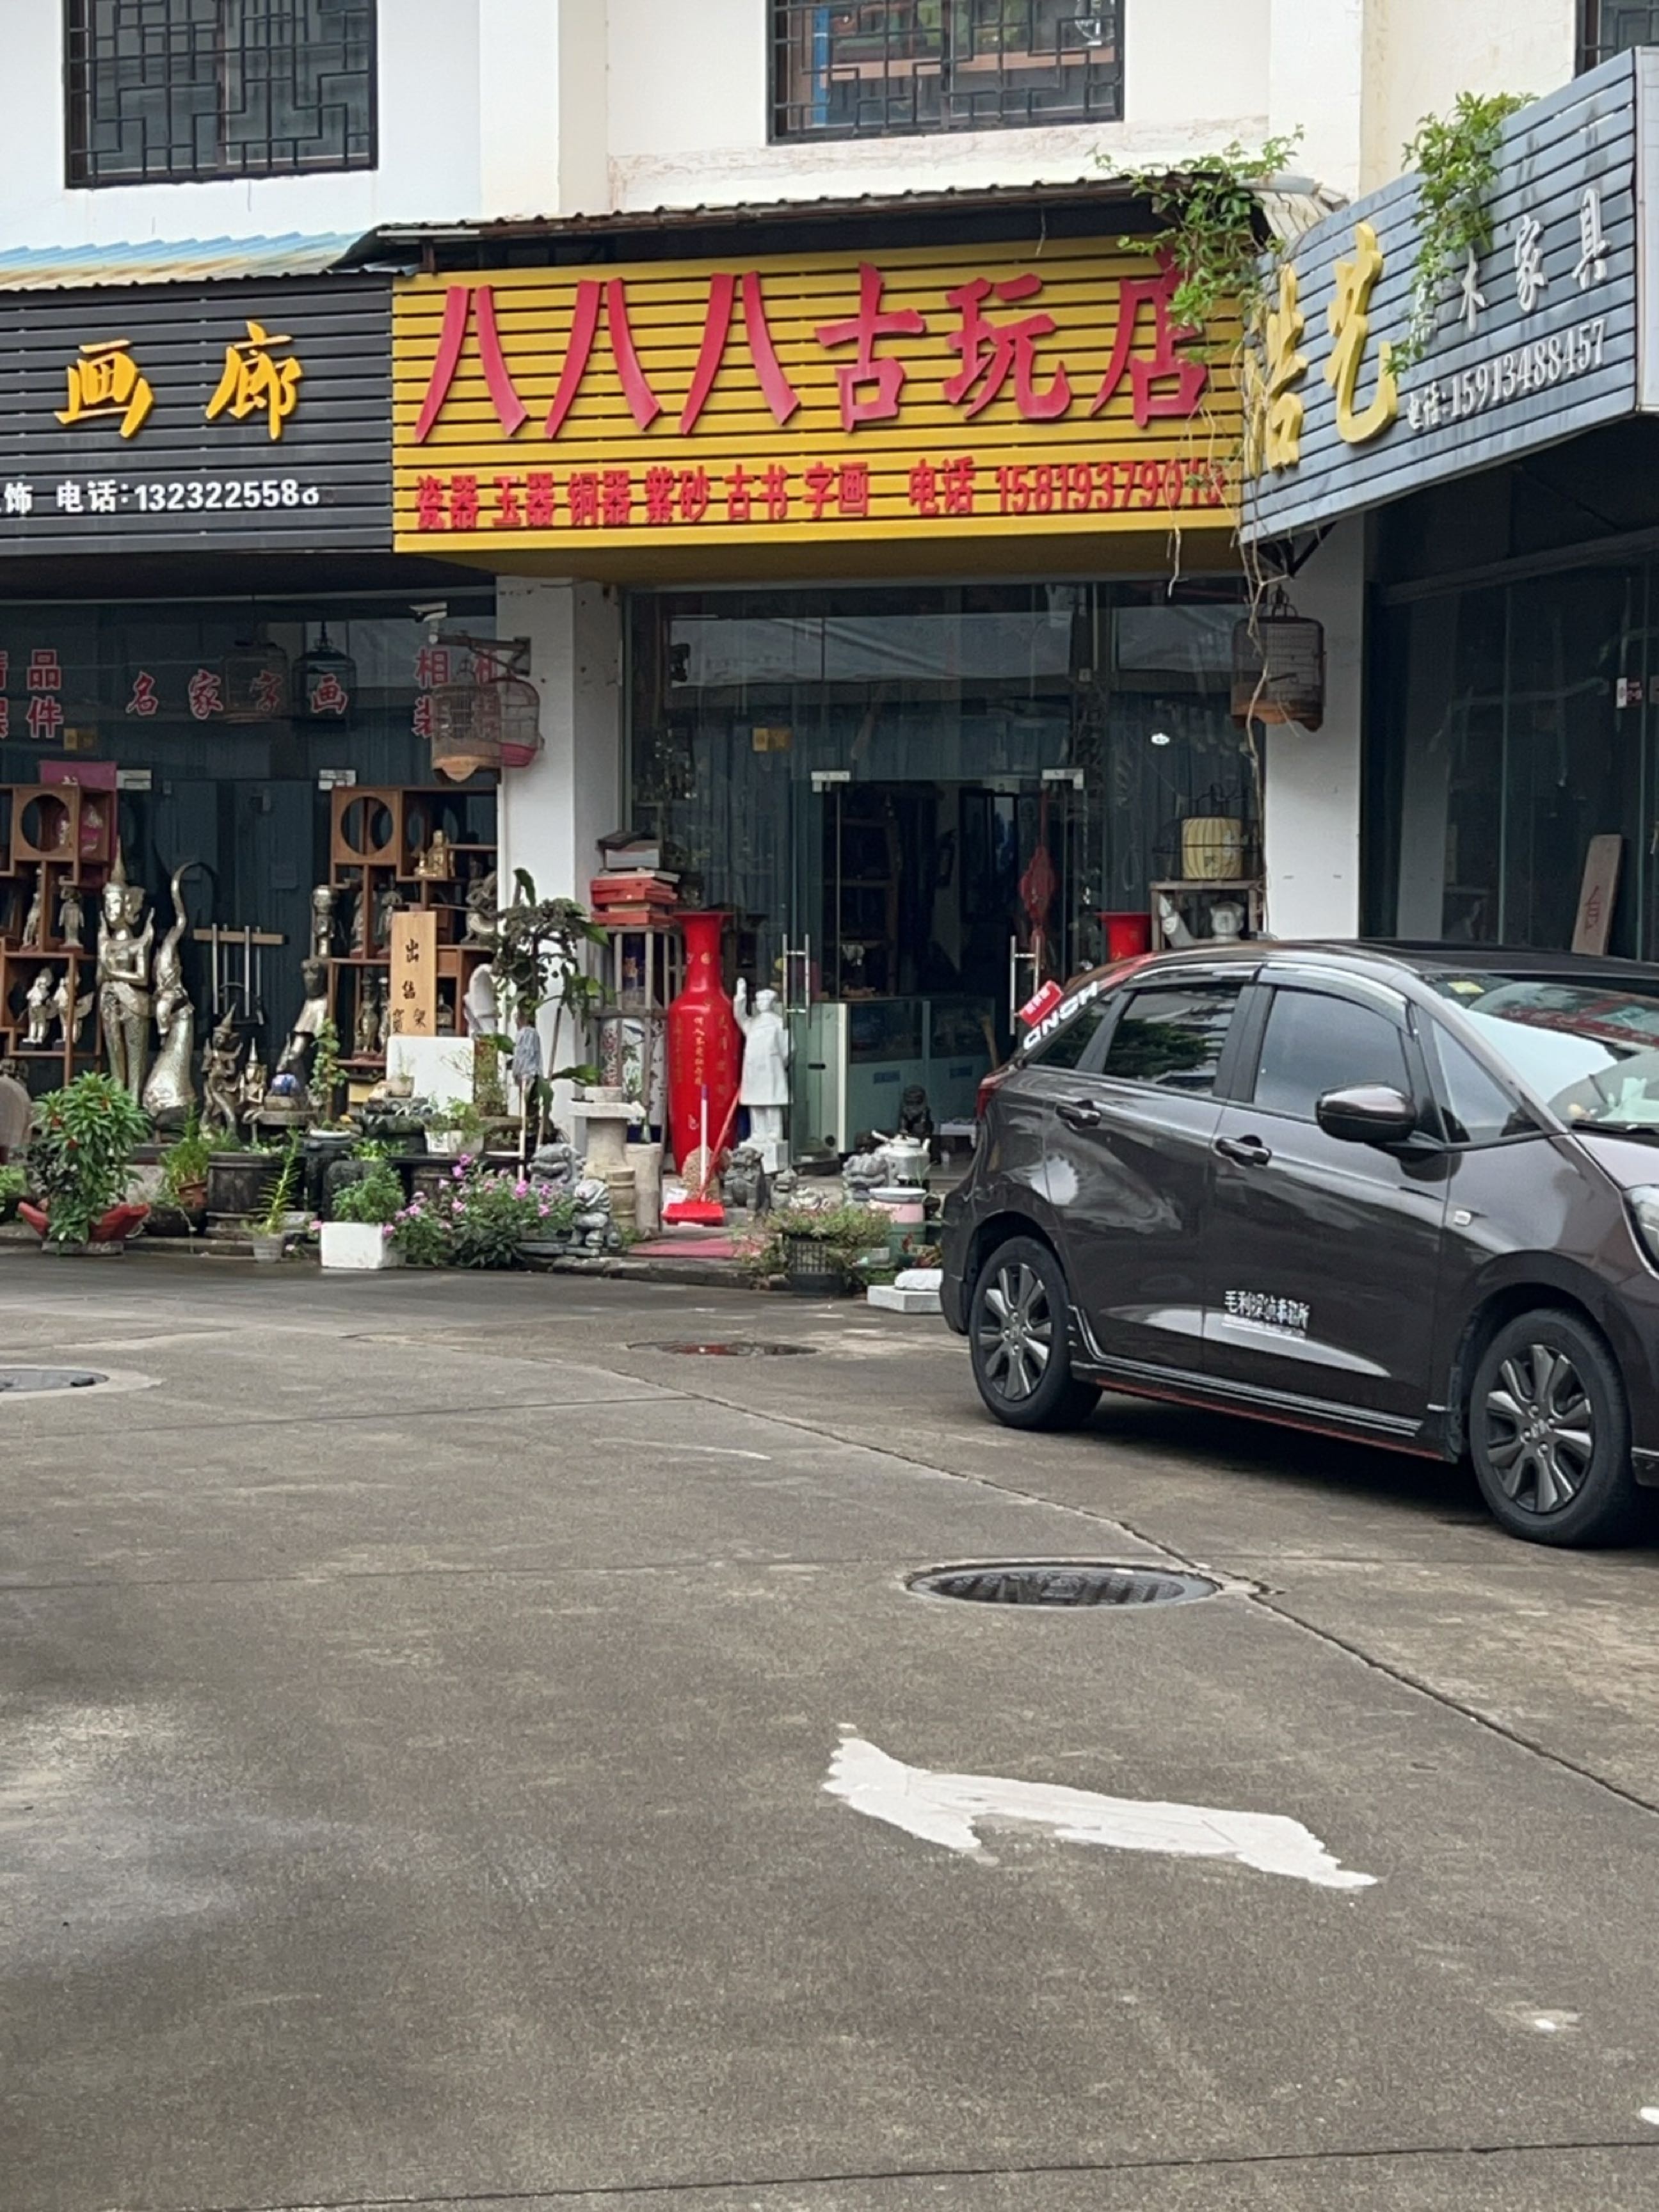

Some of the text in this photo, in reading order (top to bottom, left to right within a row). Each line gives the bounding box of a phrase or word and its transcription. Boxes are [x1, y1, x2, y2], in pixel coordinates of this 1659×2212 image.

[54, 322, 303, 441] 画廊
[415, 253, 1208, 443] 八八八古玩店
[0, 482, 33, 515] 饰
[724, 462, 789, 522] 古书
[803, 460, 869, 520] 字画
[909, 455, 976, 516] 电话
[125, 669, 348, 720] 名家字画
